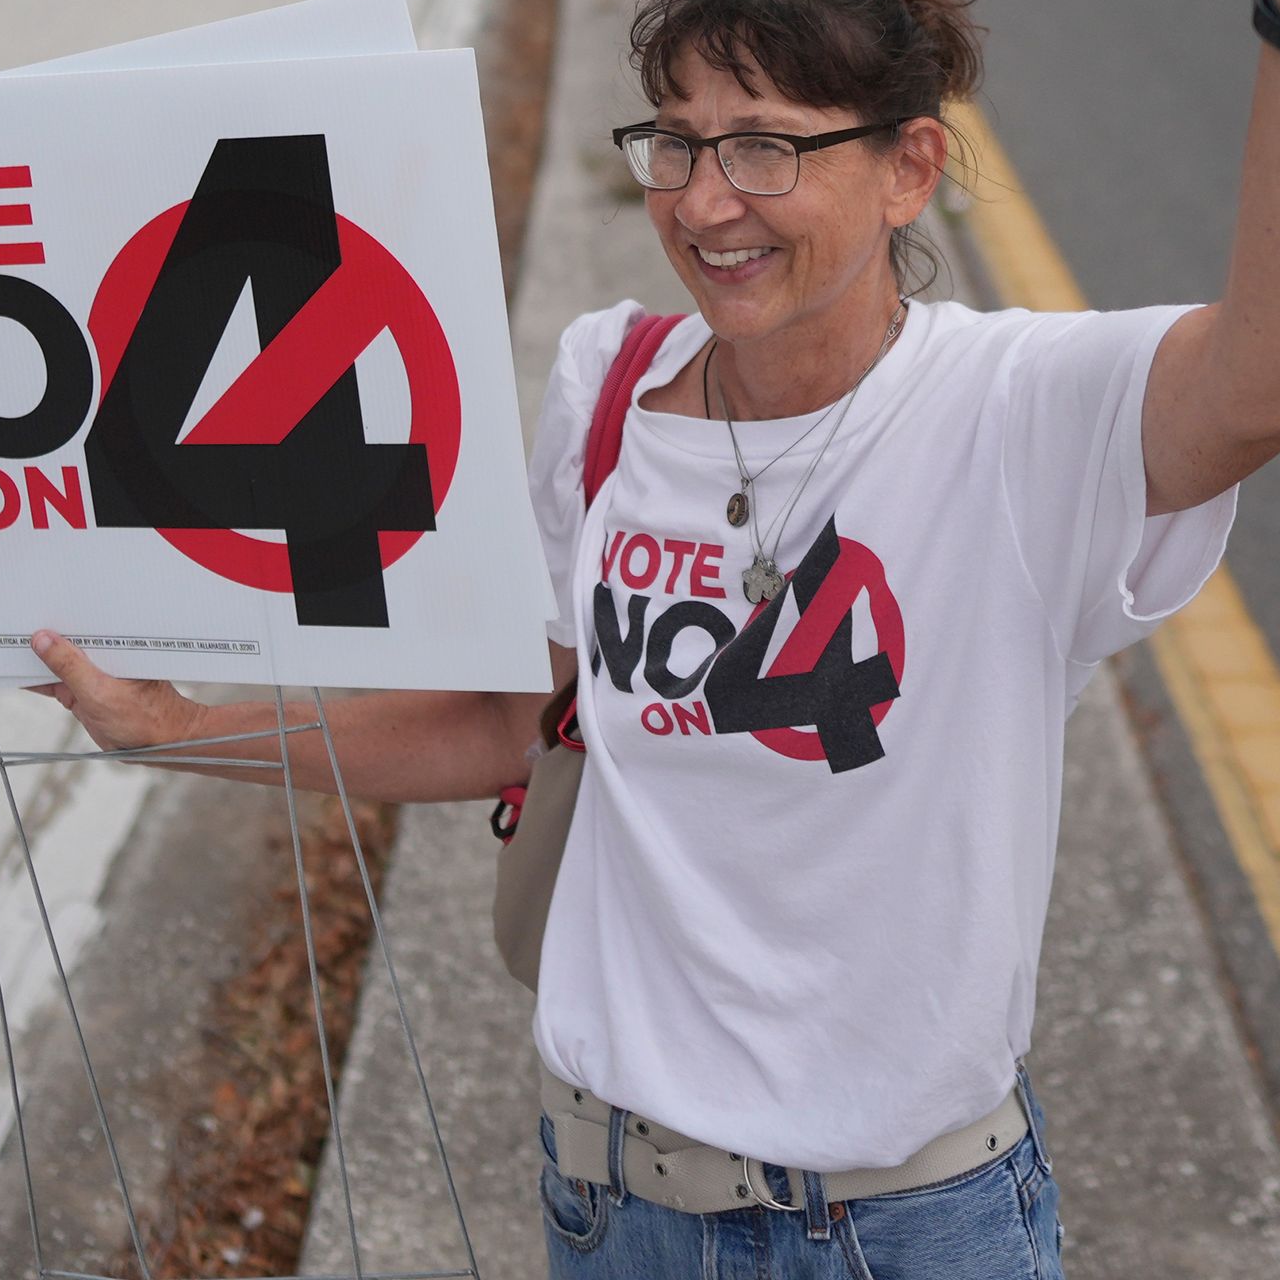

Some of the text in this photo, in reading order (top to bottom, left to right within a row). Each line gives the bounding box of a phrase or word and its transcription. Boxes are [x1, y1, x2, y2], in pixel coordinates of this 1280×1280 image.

[84, 133, 437, 628] 4
[601, 531, 726, 599] VOTE
[104, 639, 113, 647] NO
[592, 582, 737, 701] NO
[704, 514, 901, 774] 4
[641, 701, 712, 736] ON
